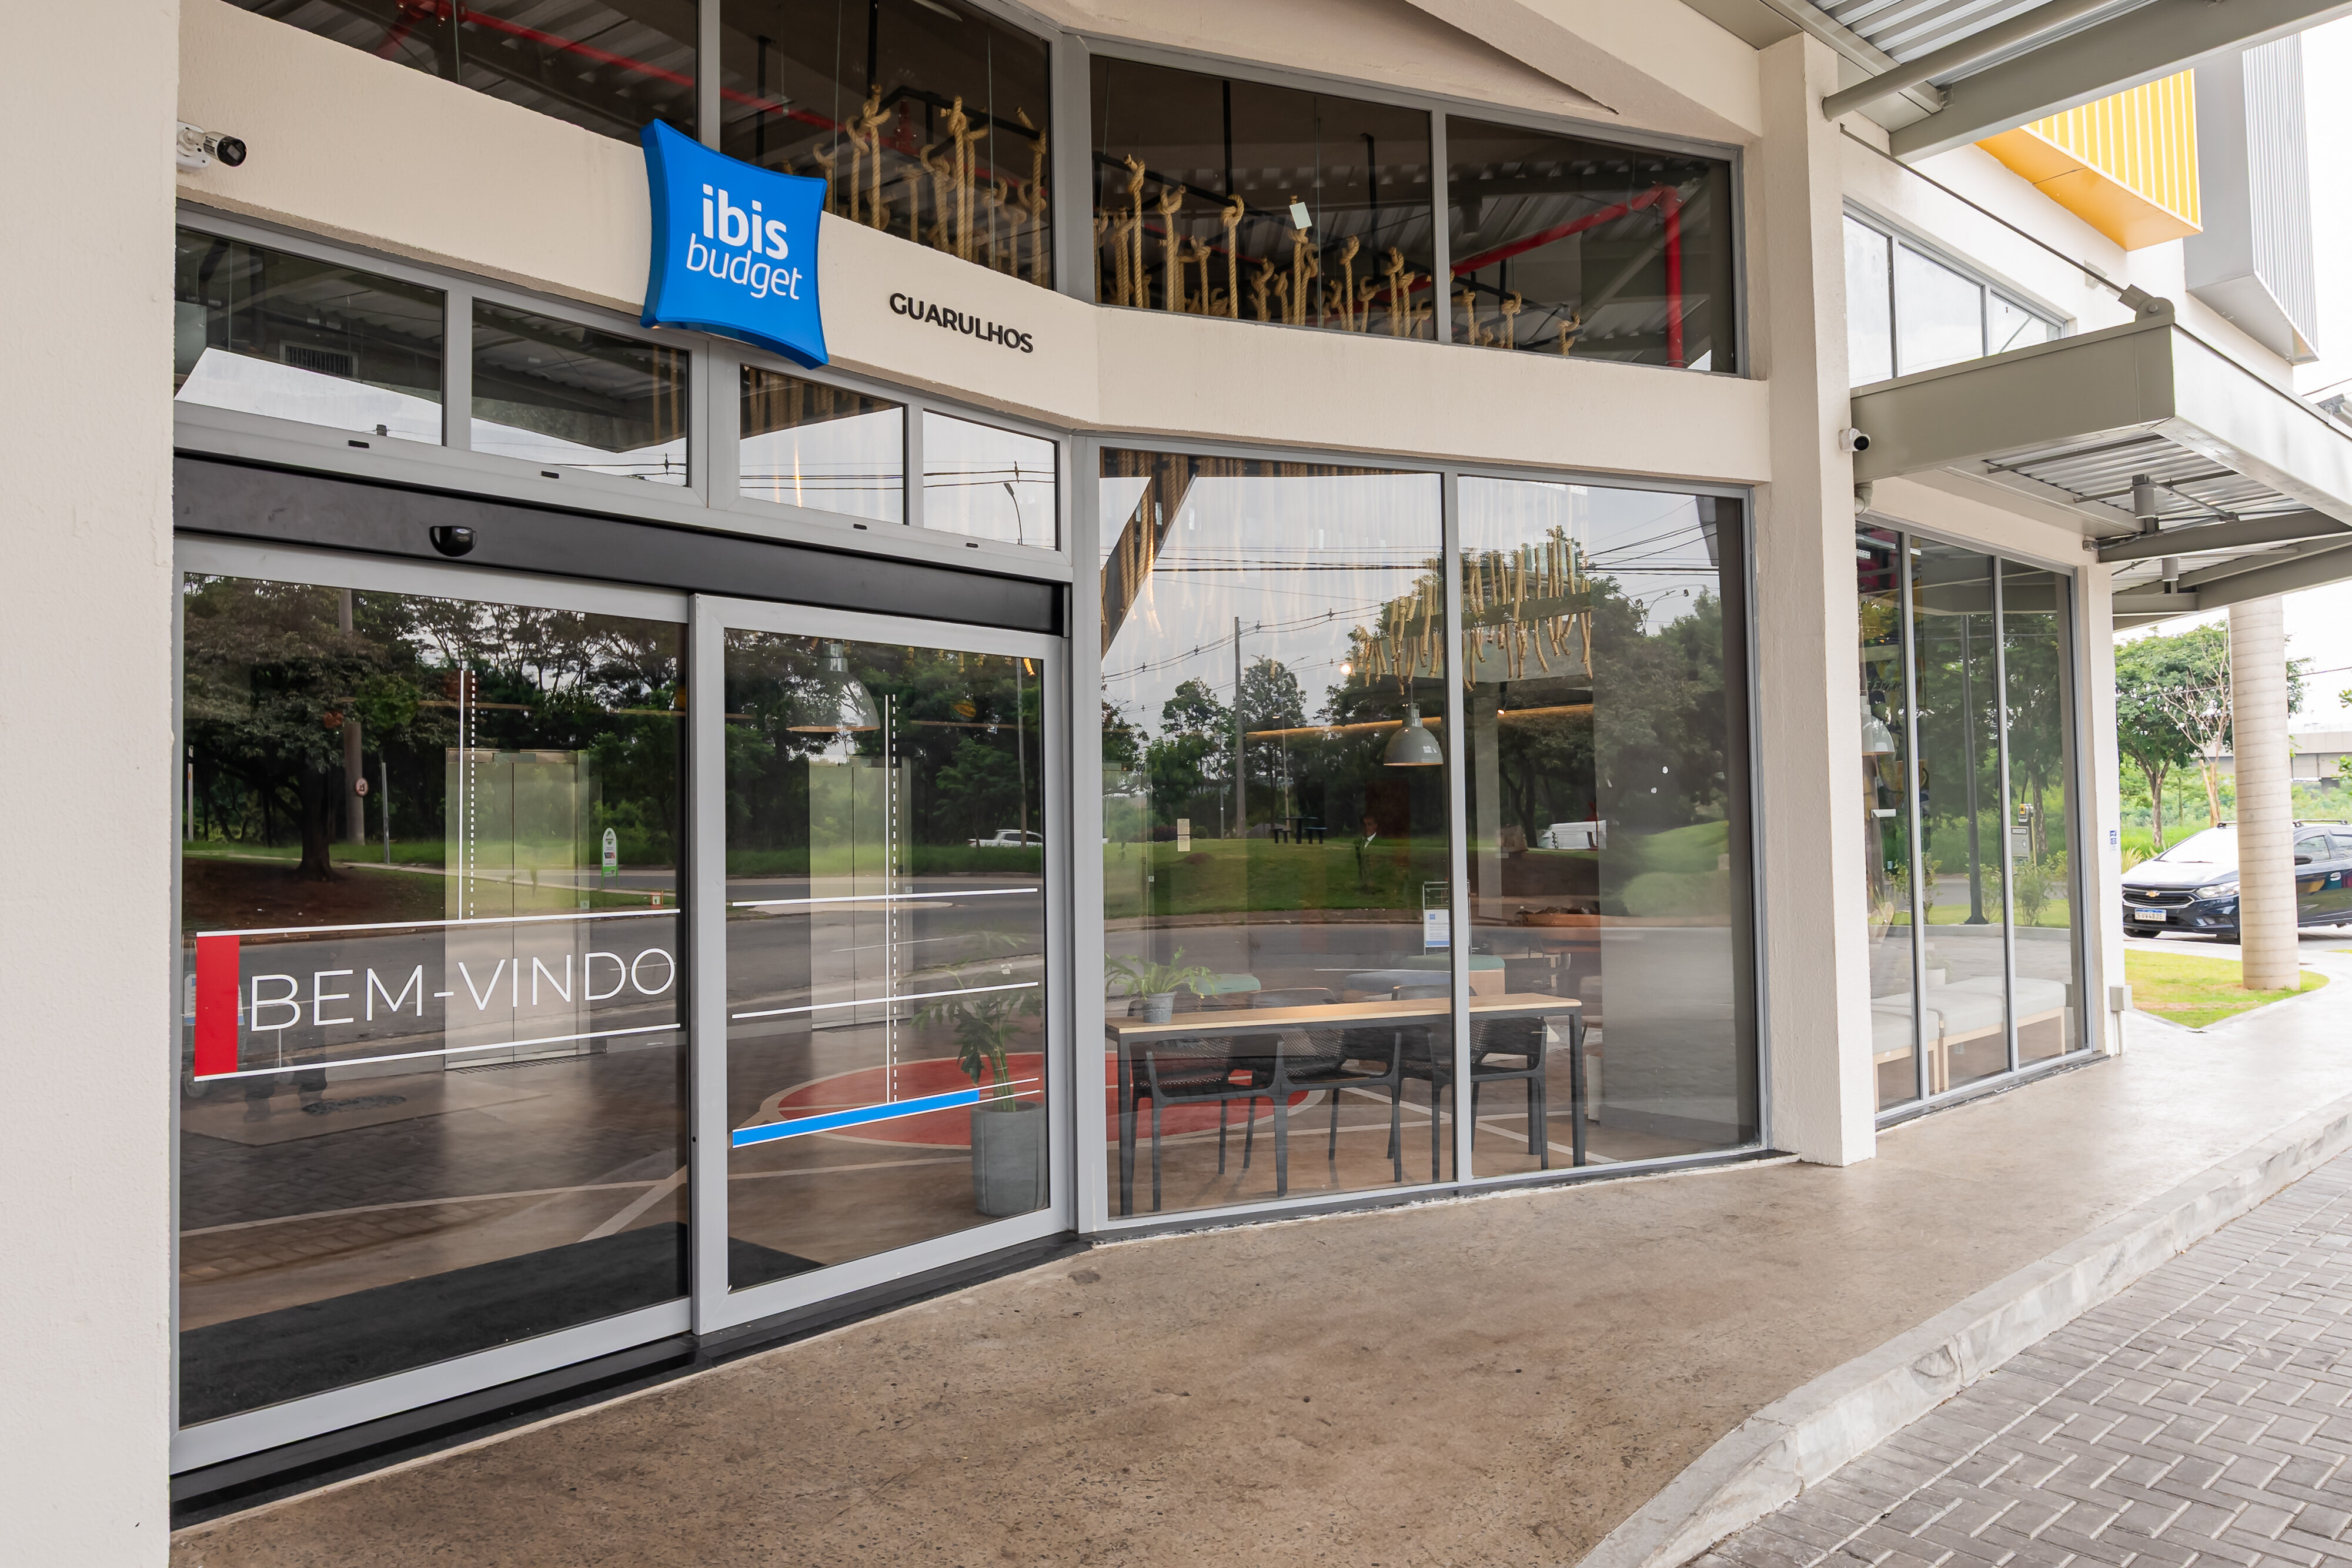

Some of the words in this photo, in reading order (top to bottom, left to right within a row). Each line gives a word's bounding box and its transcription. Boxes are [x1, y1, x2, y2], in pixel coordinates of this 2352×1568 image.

[703, 183, 789, 260] ibis
[686, 233, 803, 300] budget
[889, 293, 1034, 354] GUARULHOS
[250, 948, 676, 1032] BEM-VINDO
